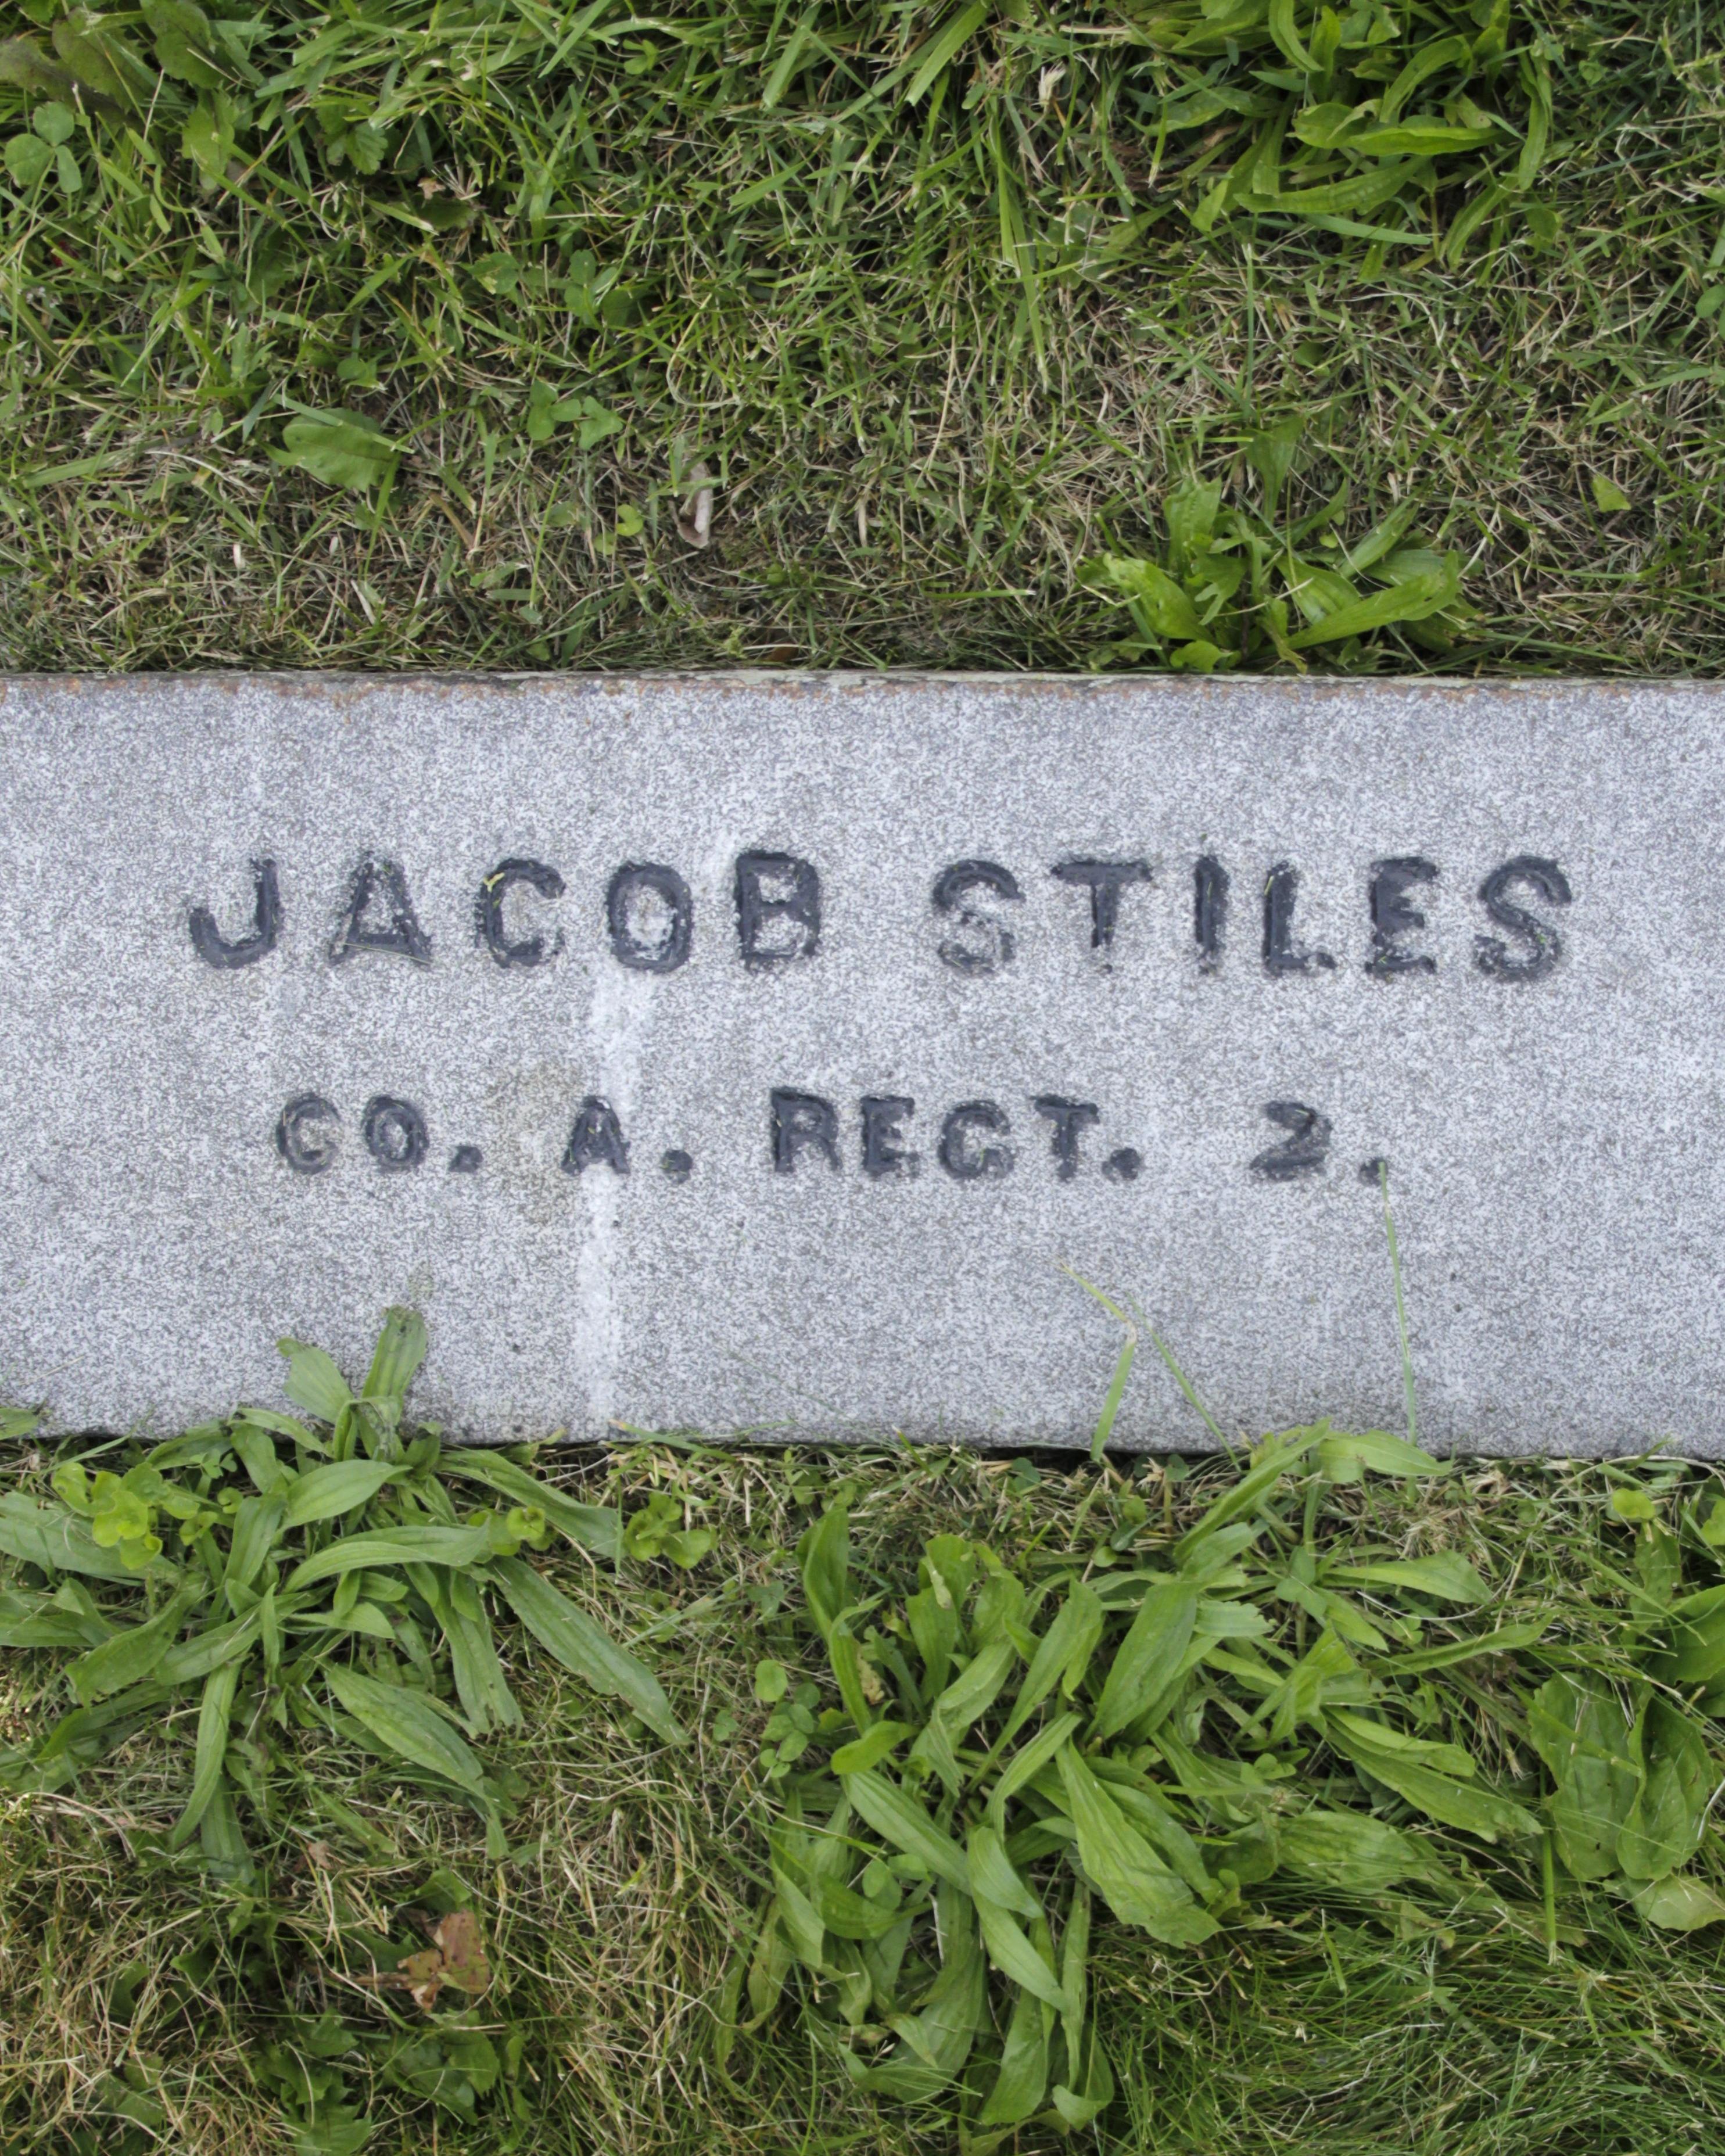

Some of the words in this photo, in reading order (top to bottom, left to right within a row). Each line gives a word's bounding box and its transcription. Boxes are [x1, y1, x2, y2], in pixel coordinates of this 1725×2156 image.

[189, 849, 821, 973] JACOB
[932, 852, 1570, 980] STILES
[275, 1093, 483, 1175] CO.
[562, 1096, 693, 1182] A.
[770, 1087, 1143, 1182] REGT.
